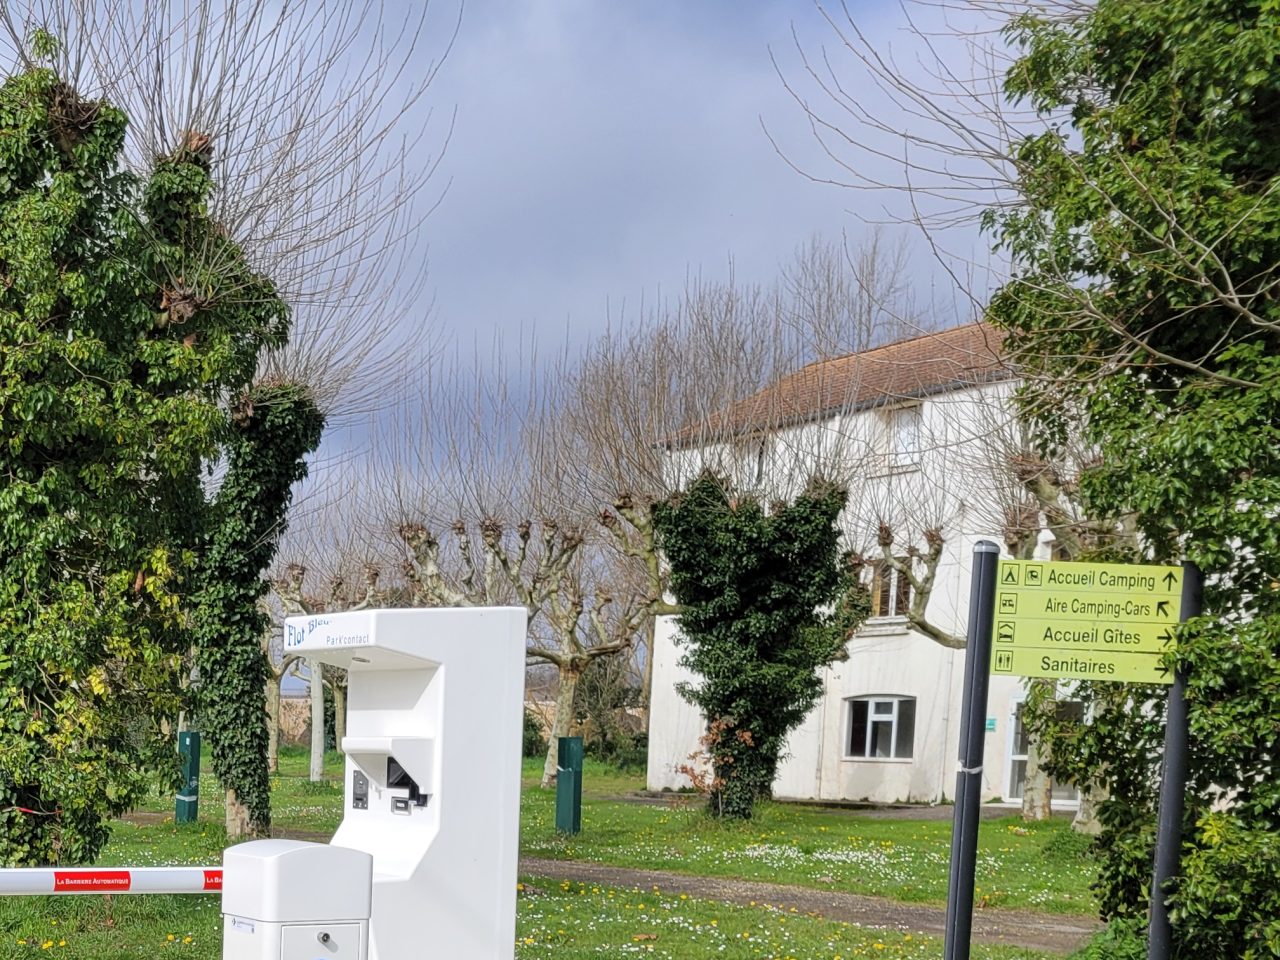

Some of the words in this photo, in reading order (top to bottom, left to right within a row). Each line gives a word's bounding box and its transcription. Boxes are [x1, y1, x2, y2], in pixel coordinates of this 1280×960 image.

[1048, 569, 1095, 586] Accueil
[1099, 572, 1155, 591] Camping
[1045, 598, 1067, 613] Aire
[1071, 600, 1150, 618] Camping-Cars
[1043, 627, 1098, 643] Accueil
[1103, 629, 1141, 645] Gîtes
[1041, 656, 1115, 674] Sanitaires
